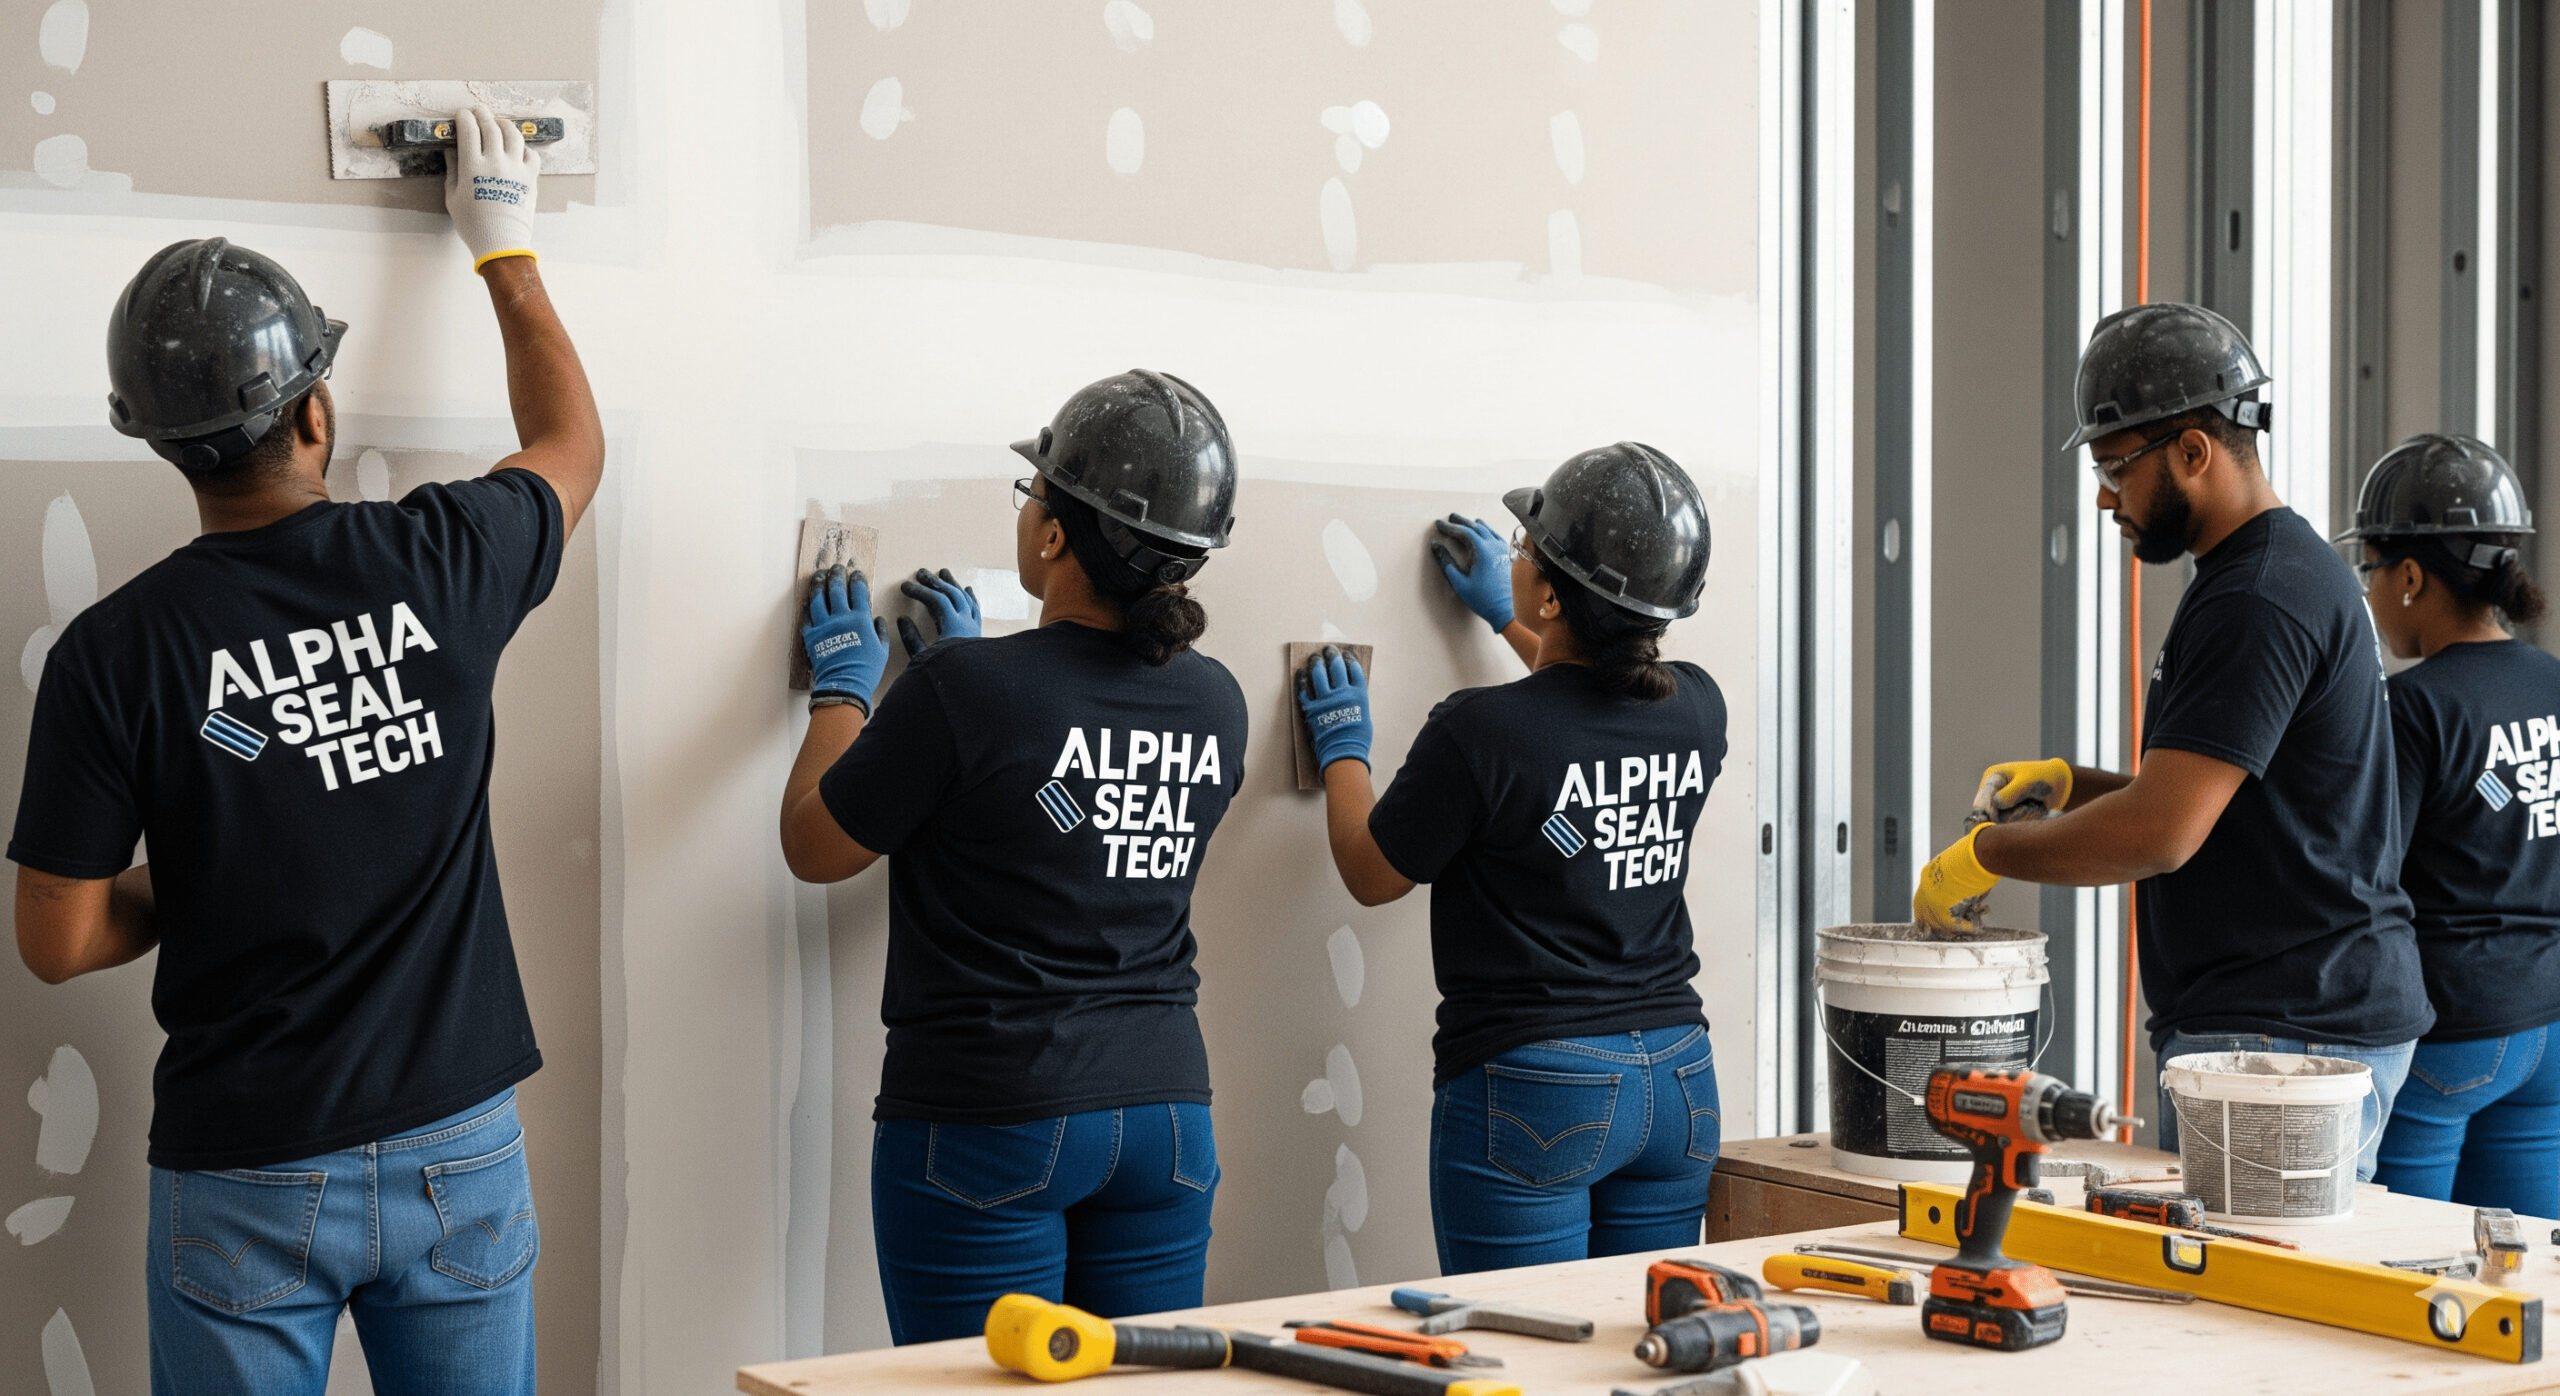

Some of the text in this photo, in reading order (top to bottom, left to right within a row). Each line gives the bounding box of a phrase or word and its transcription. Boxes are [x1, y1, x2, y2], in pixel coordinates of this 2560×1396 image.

[208, 601, 439, 711] ALPHA
[271, 666, 424, 745] SEAL
[304, 710, 444, 791] TECH
[1051, 727, 1221, 785] ALPHA
[1092, 783, 1196, 833] SEAL
[1553, 750, 1704, 812] ALPHA
[1593, 800, 1684, 849] SEAL
[2527, 799, 2560, 841] TE
[1102, 834, 1196, 879] TECH
[1603, 841, 1685, 891] TECH
